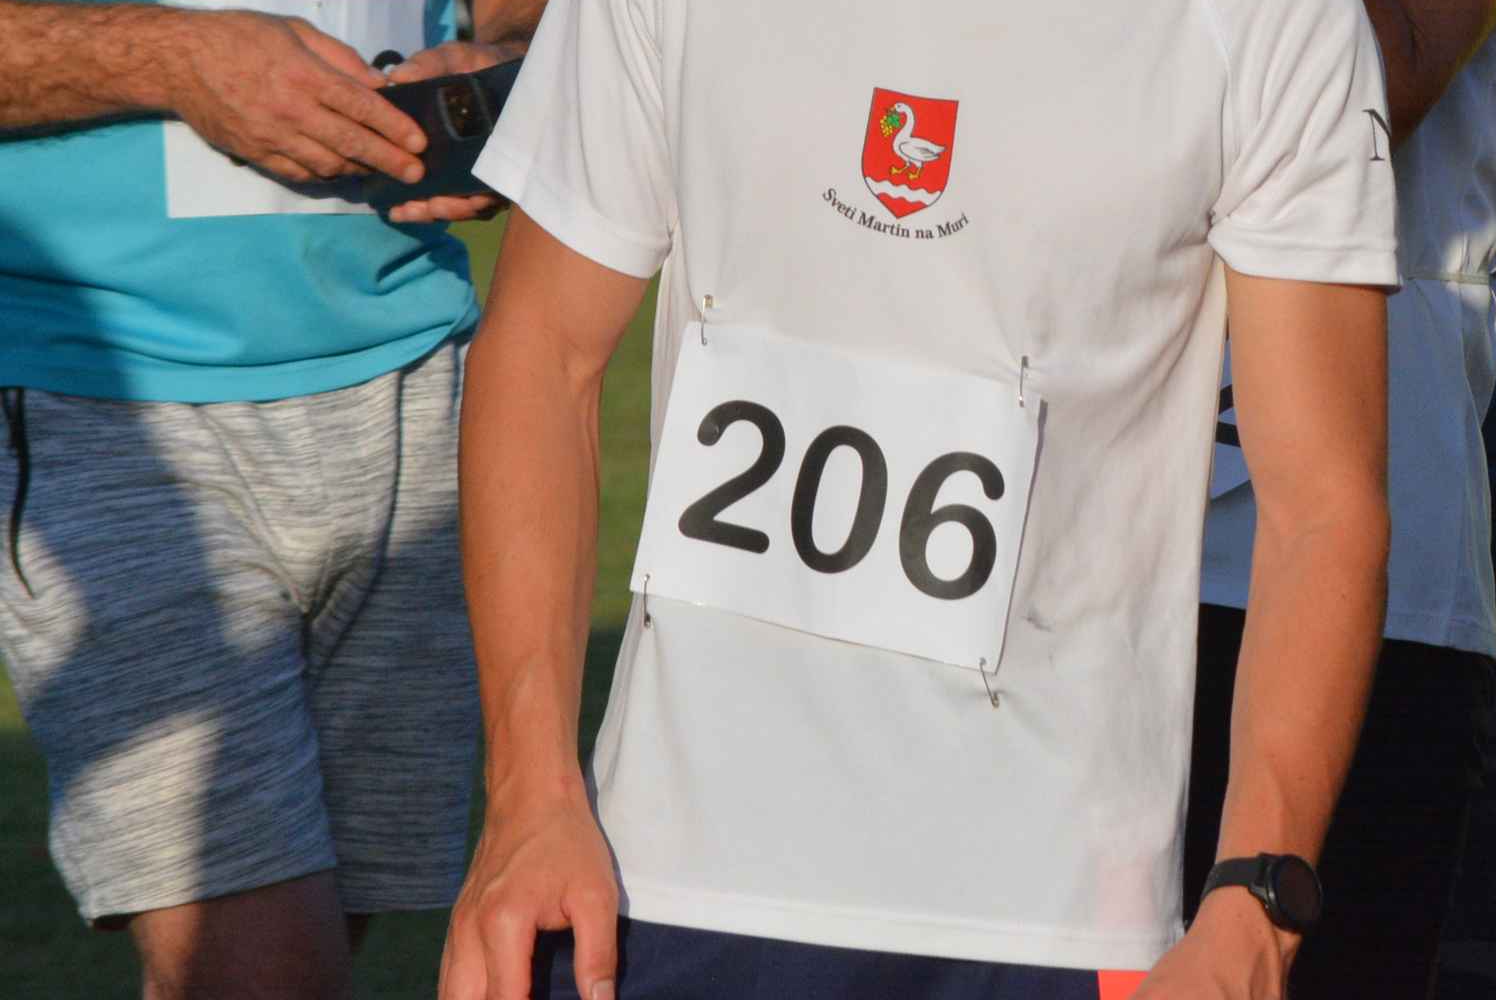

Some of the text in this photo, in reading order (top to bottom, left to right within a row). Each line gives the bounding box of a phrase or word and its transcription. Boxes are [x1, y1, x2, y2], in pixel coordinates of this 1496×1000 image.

[822, 187, 969, 240] Sveti Martin na Muri
[678, 400, 1005, 600] 206
